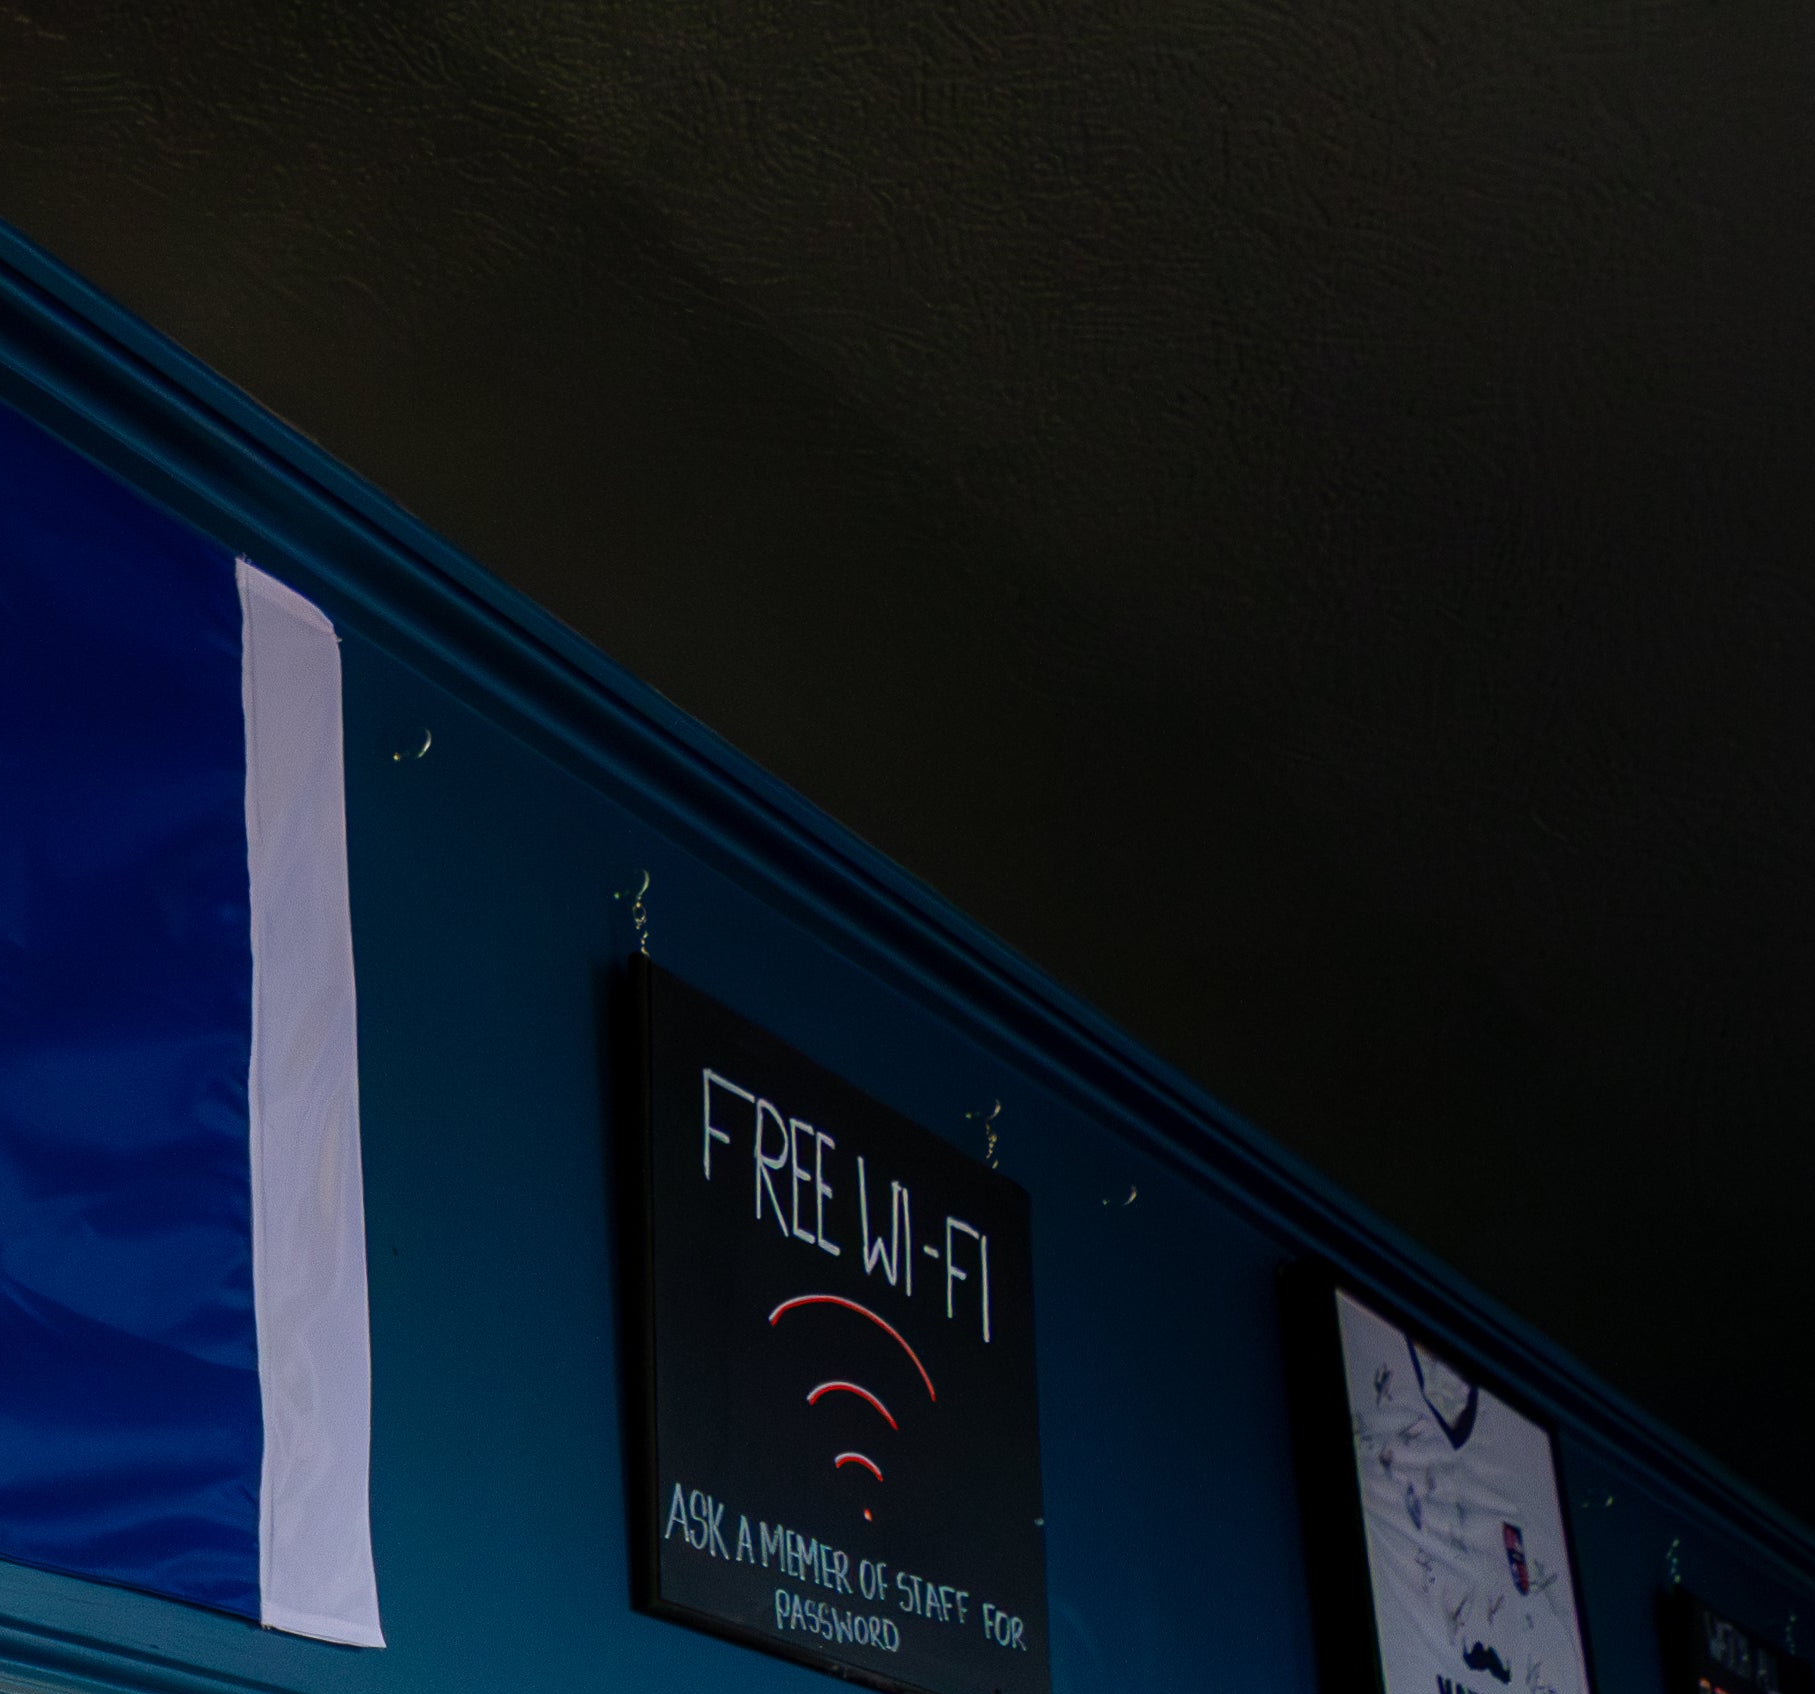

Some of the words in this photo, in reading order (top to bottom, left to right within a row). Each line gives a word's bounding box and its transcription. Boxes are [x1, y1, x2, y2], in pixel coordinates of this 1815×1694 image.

[702, 1067, 841, 1257] FREE
[856, 1155, 991, 1344] WI-FI
[664, 1482, 730, 1561] ASK
[735, 1514, 756, 1564] A
[858, 1558, 889, 1601] OF
[895, 1570, 970, 1625] STAFF
[982, 1601, 1027, 1652] FOR
[774, 1588, 901, 1653] PASSWORD
